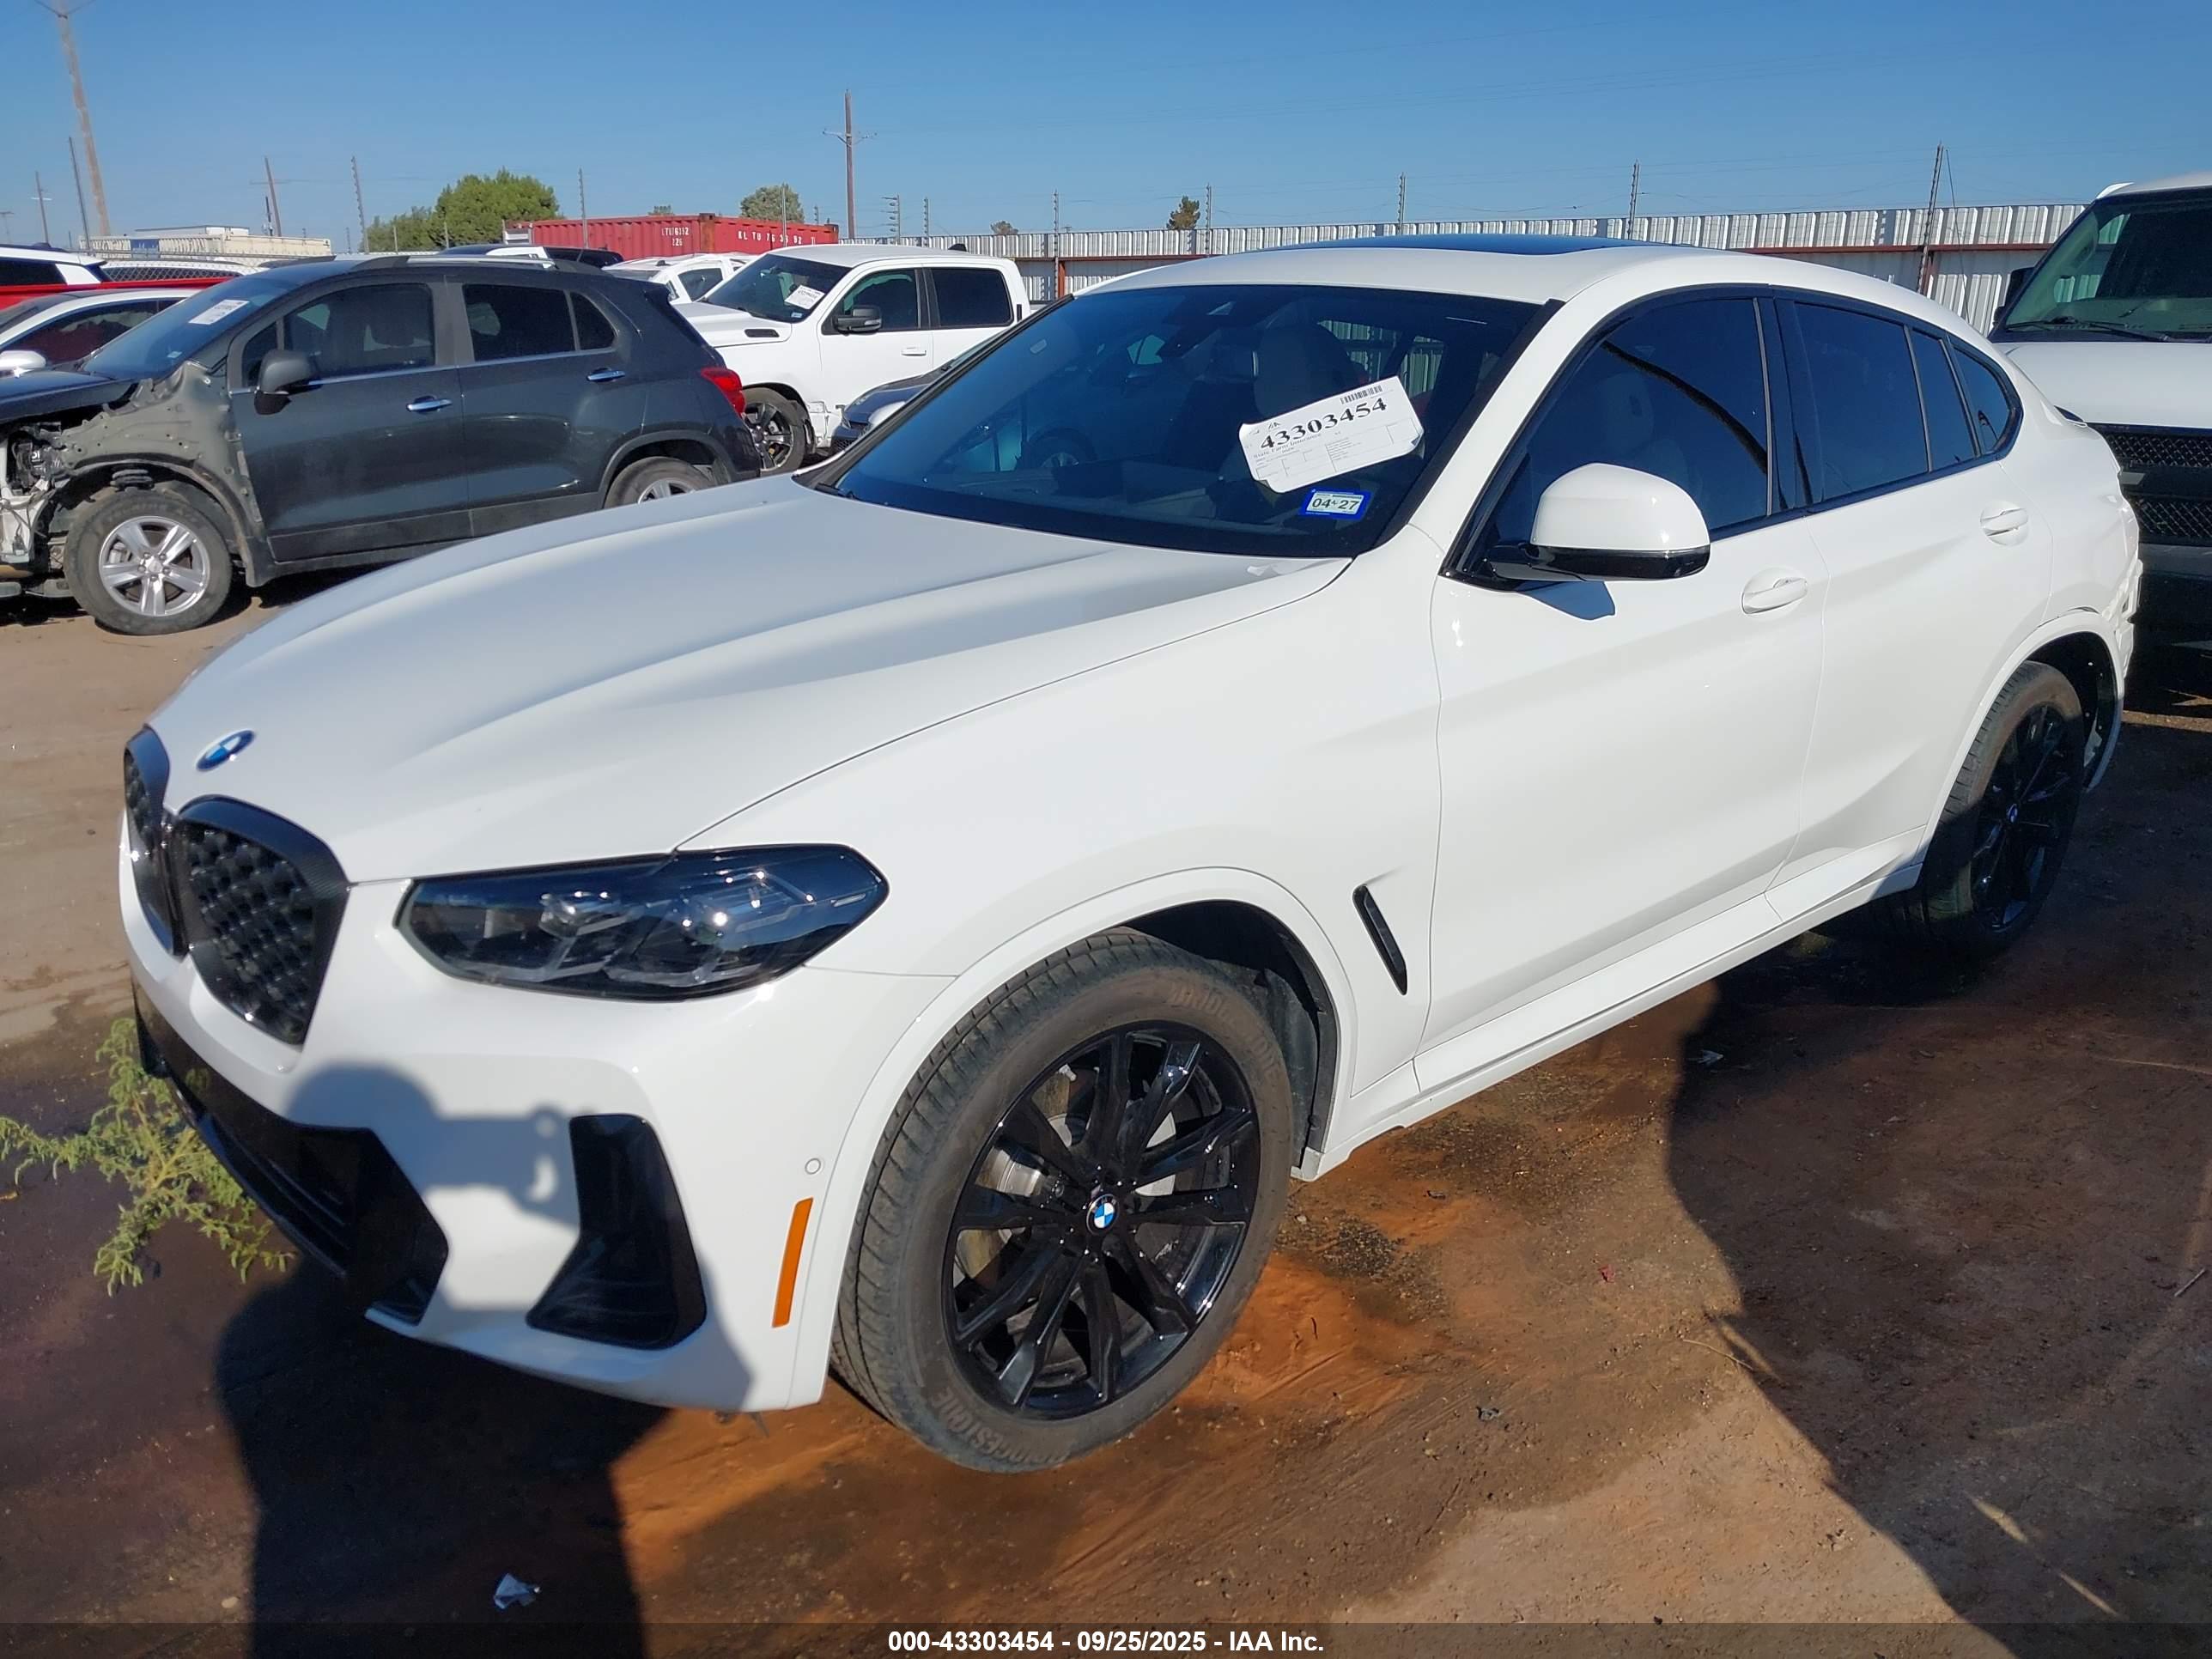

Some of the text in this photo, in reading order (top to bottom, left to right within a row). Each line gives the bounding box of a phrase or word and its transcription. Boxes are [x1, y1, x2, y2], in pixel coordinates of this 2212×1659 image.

[1261, 398, 1387, 448] 43303454
[1312, 498, 1359, 510] 04 27
